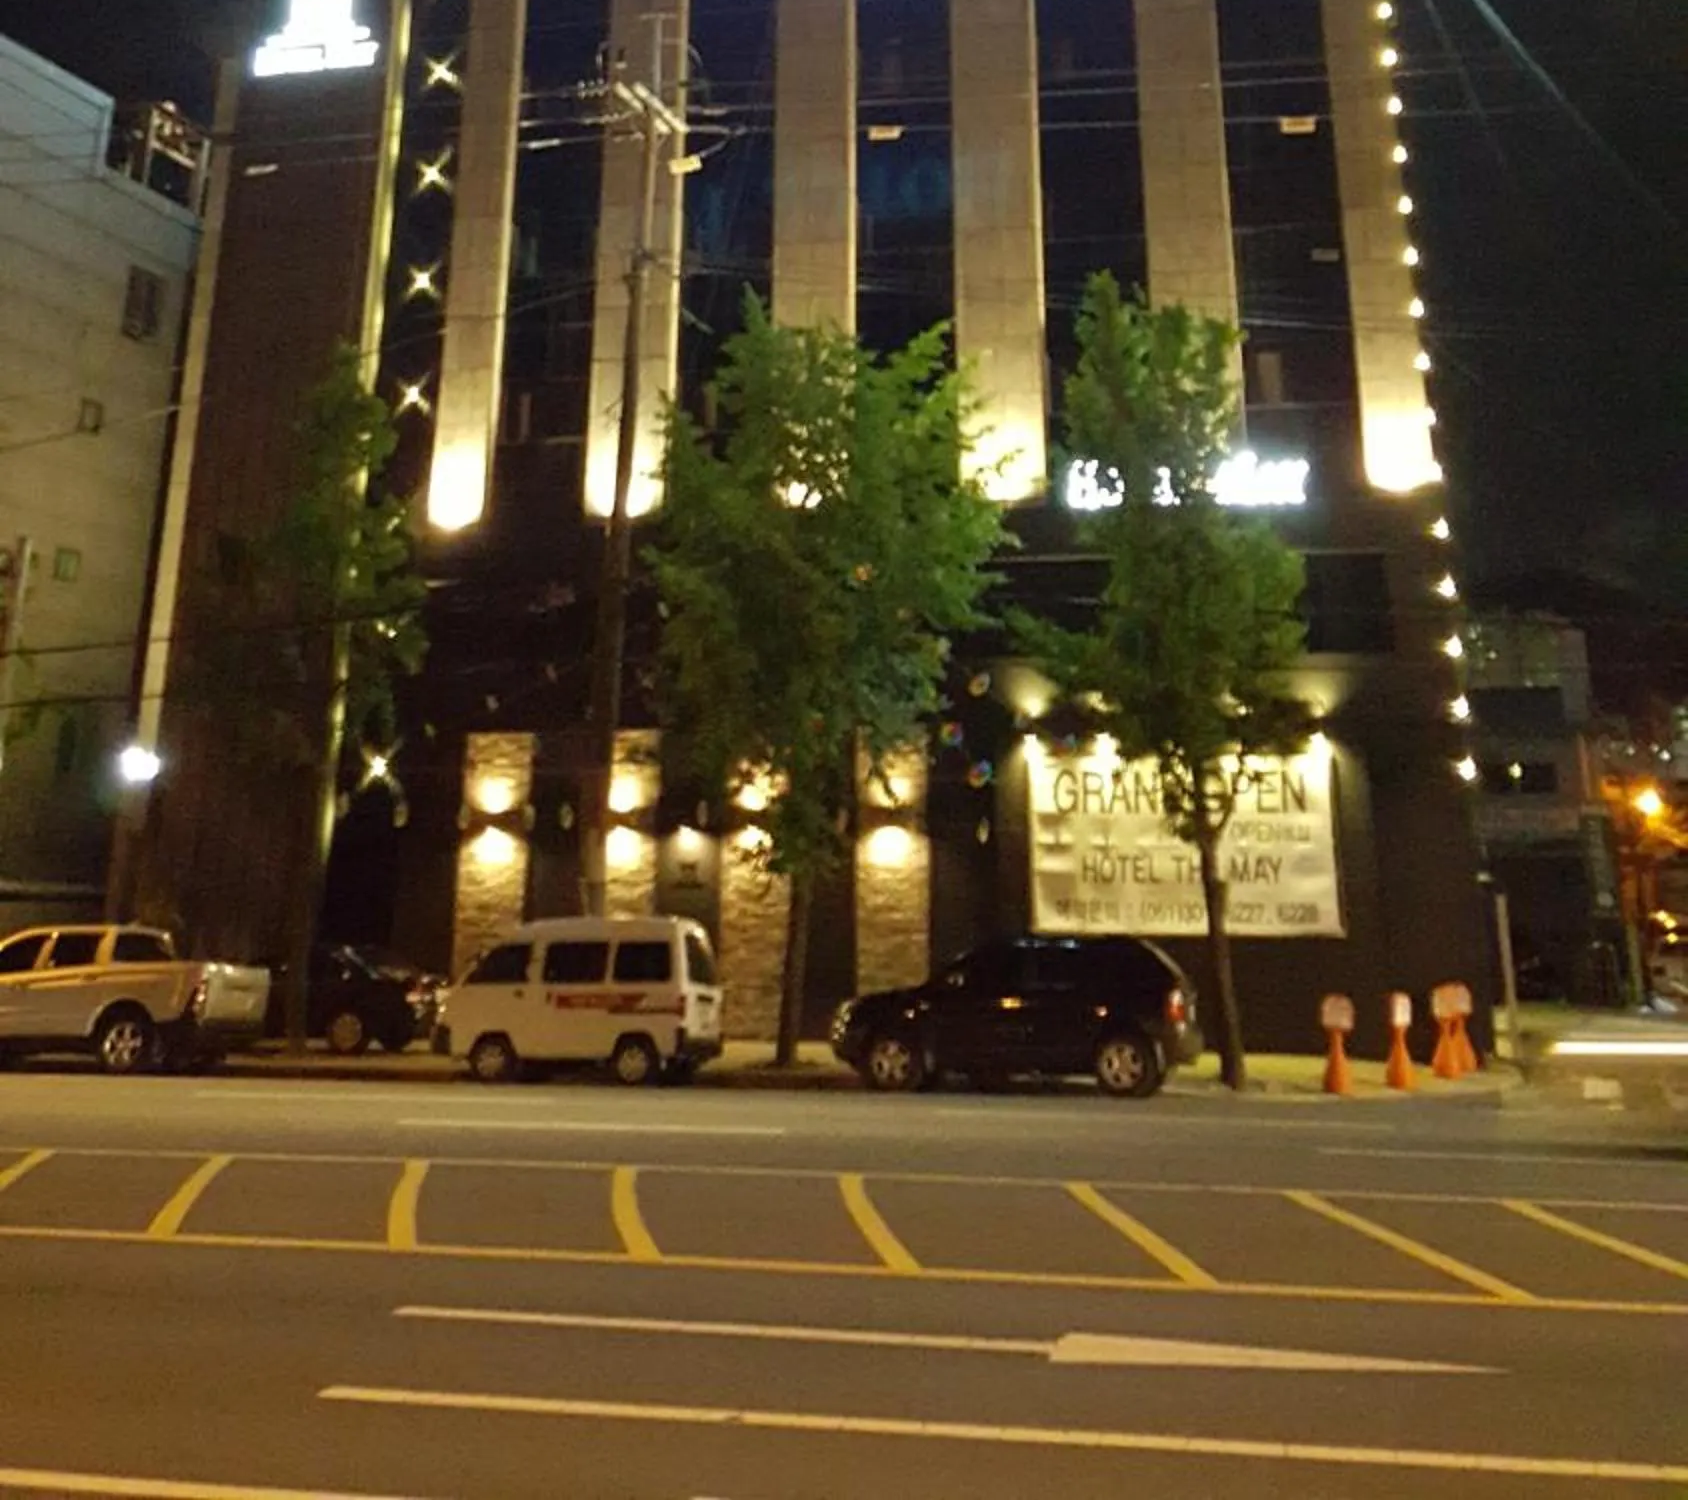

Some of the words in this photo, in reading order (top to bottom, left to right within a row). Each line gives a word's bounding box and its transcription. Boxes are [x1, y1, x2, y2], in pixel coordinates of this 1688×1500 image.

[1053, 769, 1180, 815] GRAN
[1082, 855, 1161, 884] HOTEL
[1172, 855, 1210, 884] TH
[1230, 852, 1282, 884] MAY
